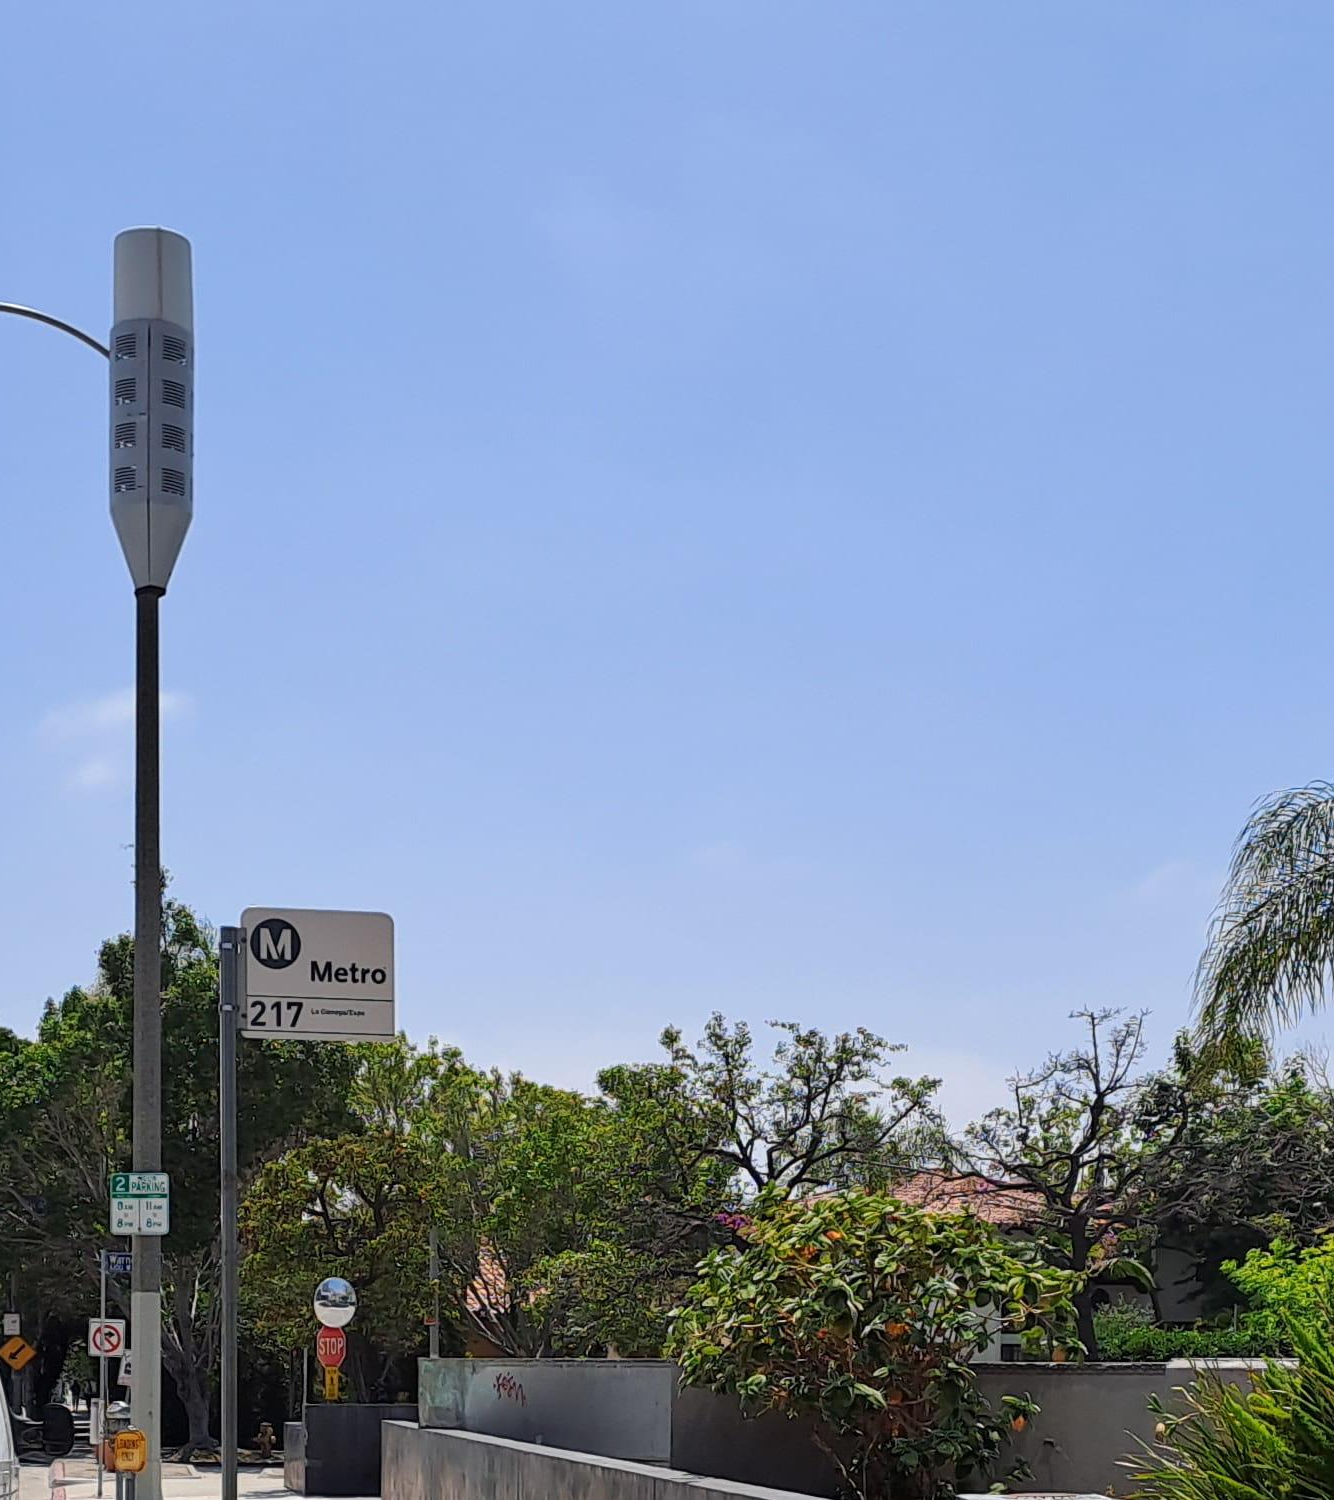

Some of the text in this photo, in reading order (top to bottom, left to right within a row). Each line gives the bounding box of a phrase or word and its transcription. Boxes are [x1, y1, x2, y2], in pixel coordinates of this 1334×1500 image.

[310, 960, 387, 984] Metro
[250, 1000, 304, 1028] 217
[115, 1176, 126, 1191] 2
[131, 1182, 165, 1192] PARKING
[318, 1337, 344, 1355] STOP
